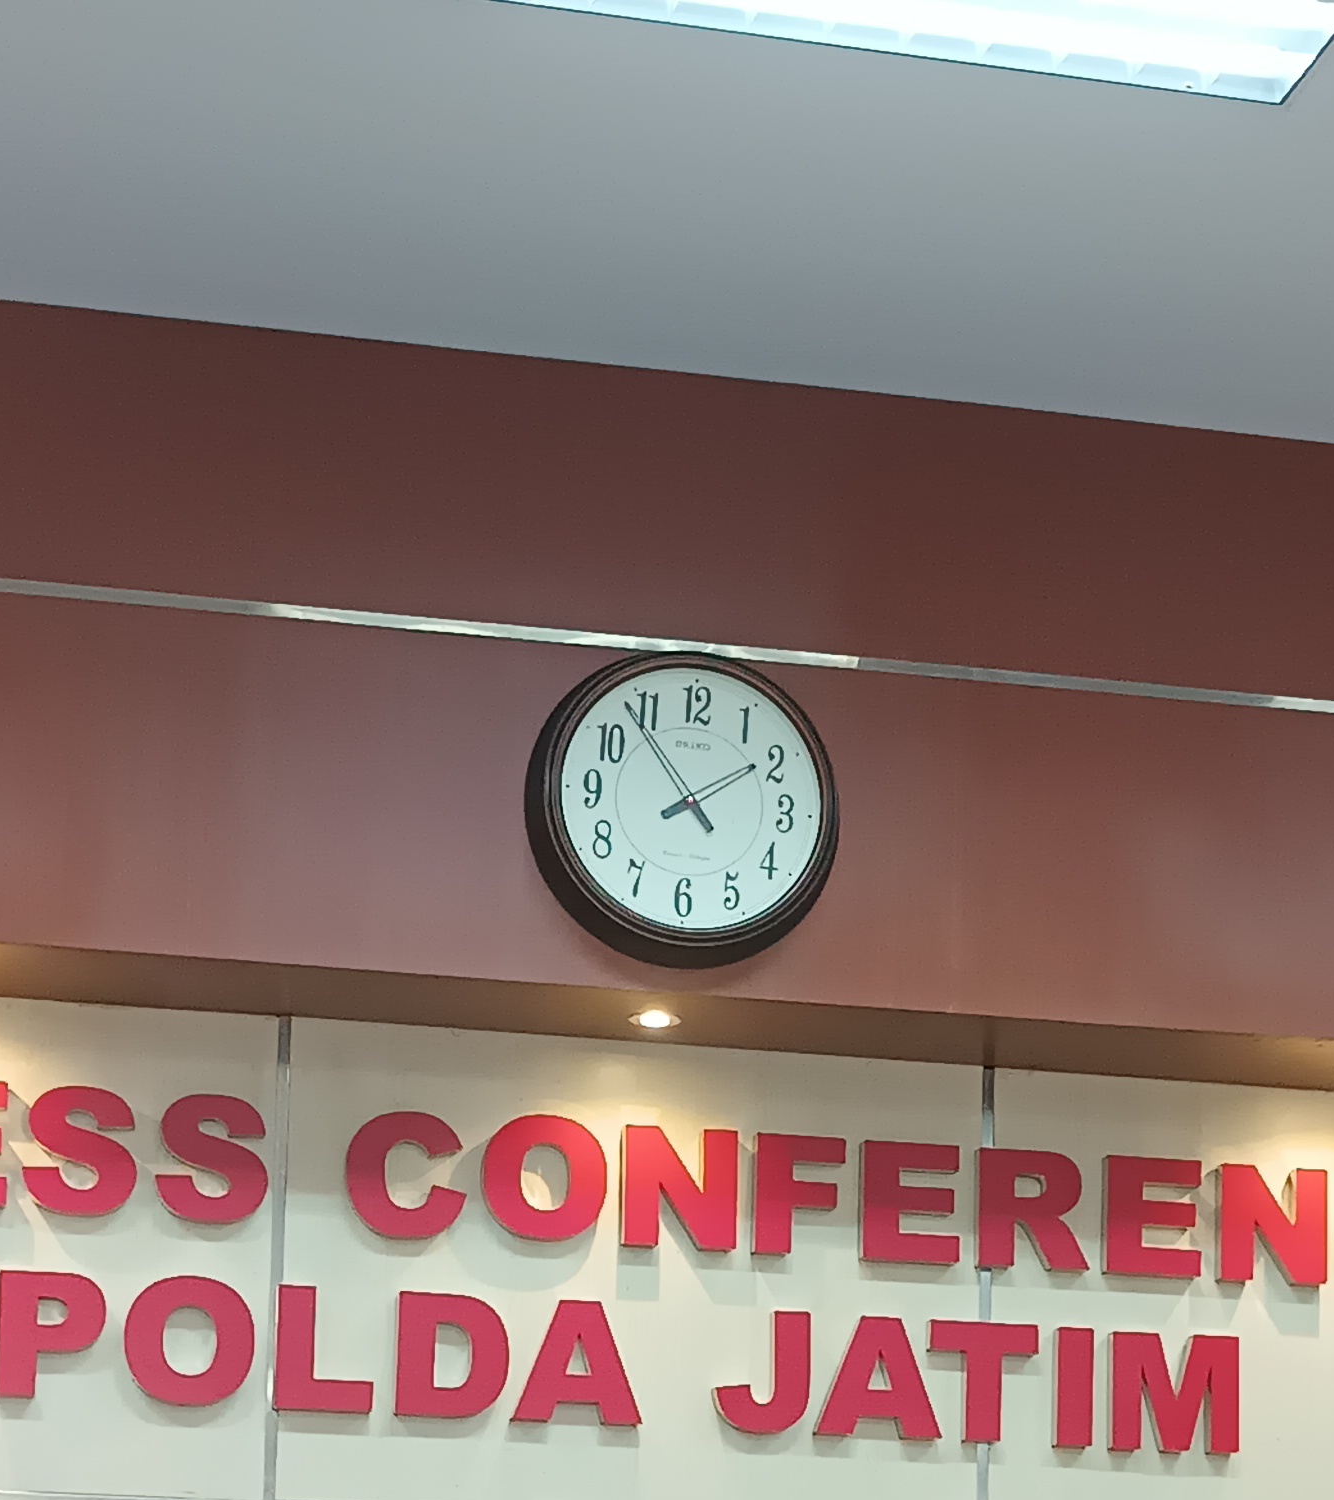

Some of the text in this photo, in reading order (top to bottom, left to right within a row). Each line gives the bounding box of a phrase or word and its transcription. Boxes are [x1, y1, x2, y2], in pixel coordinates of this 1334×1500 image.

[637, 691, 659, 731] 11
[683, 685, 712, 726] 12
[739, 706, 750, 744] 1
[597, 723, 625, 764] 10
[766, 745, 785, 783] 2
[583, 769, 602, 809] 9
[776, 794, 794, 833] 3
[593, 820, 612, 859] 8
[627, 858, 645, 898] 7
[759, 841, 778, 880] 4
[674, 877, 693, 917] 6
[723, 871, 740, 911] 5
[712, 1309, 1240, 1456] JATIM
